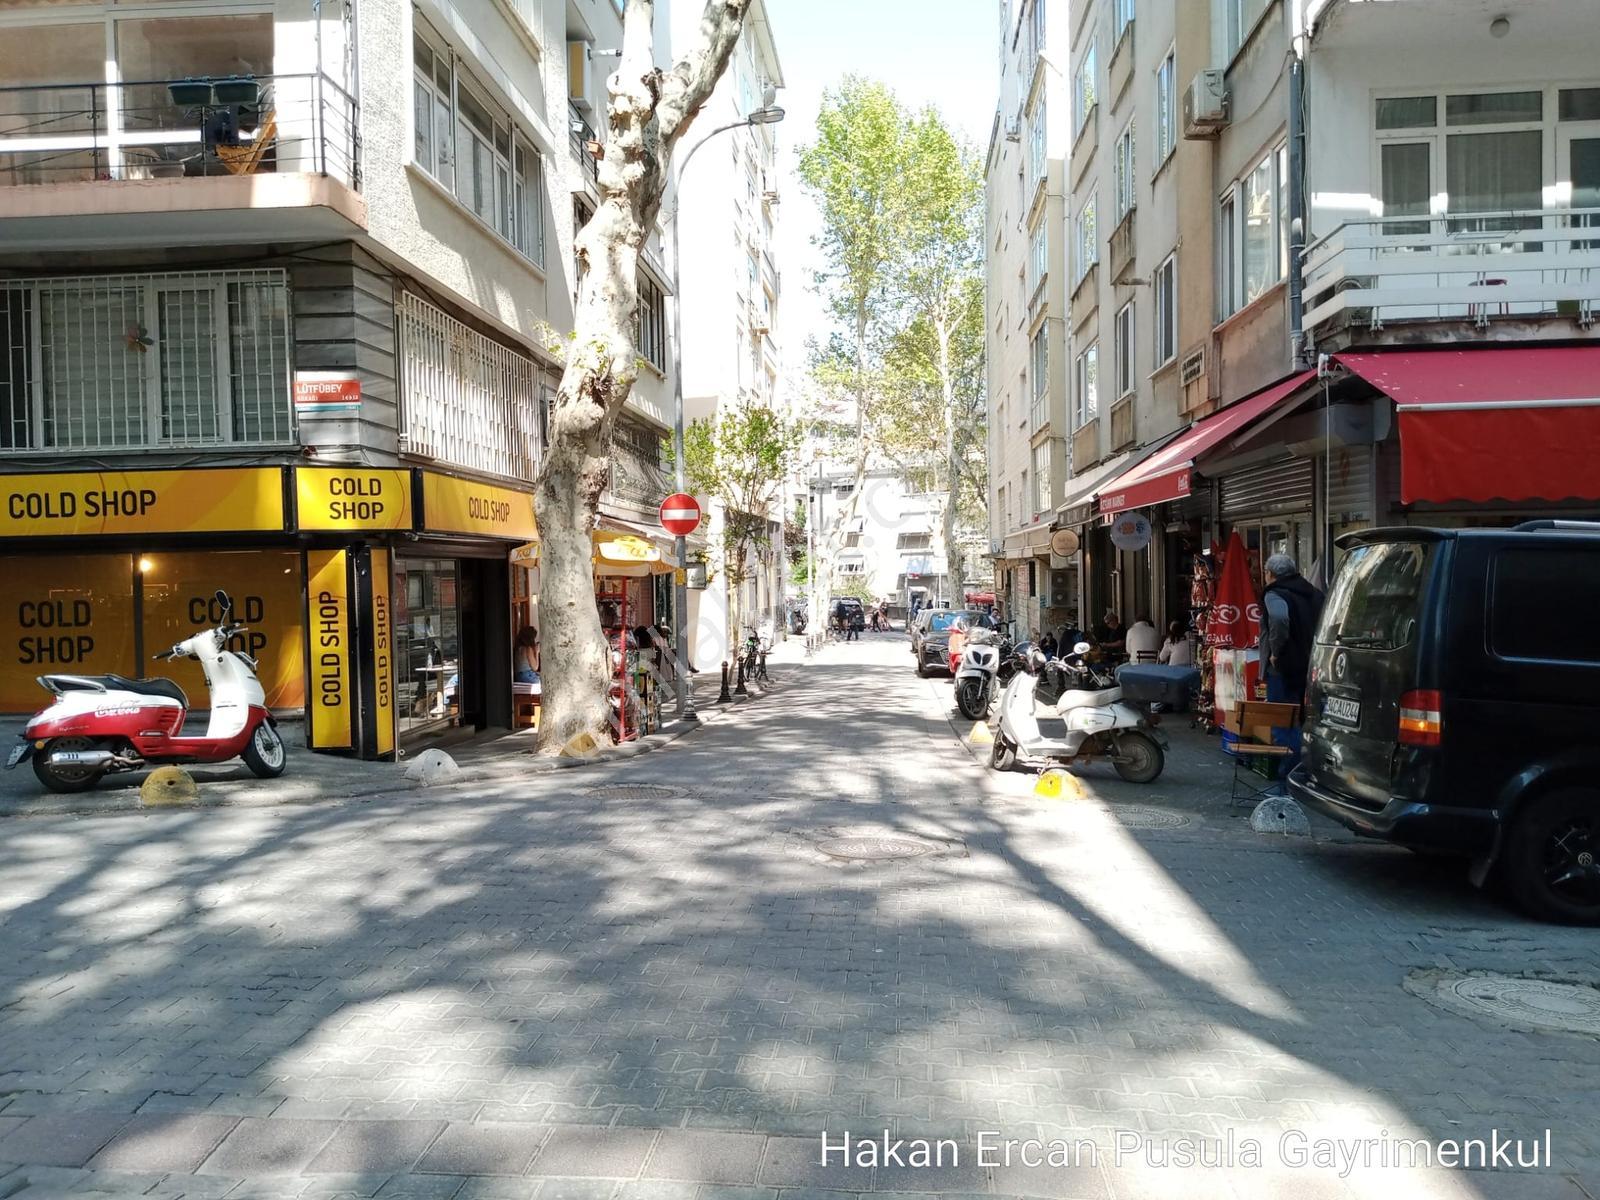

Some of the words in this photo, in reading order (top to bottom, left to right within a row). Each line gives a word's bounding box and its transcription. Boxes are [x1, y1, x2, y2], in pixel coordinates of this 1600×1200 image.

[329, 478, 382, 496] COLD
[8, 492, 77, 519] COLD
[84, 489, 157, 517] SHOP
[329, 502, 385, 520] SHOP
[468, 496, 489, 522] COLD
[490, 500, 510, 523] SHOP
[18, 600, 92, 628] COLD
[188, 596, 264, 624] COLD
[318, 591, 340, 647] SHOP
[376, 595, 387, 649] SHOP
[18, 636, 95, 665] SHOP
[320, 653, 342, 707] COLD
[378, 655, 389, 708] COLD
